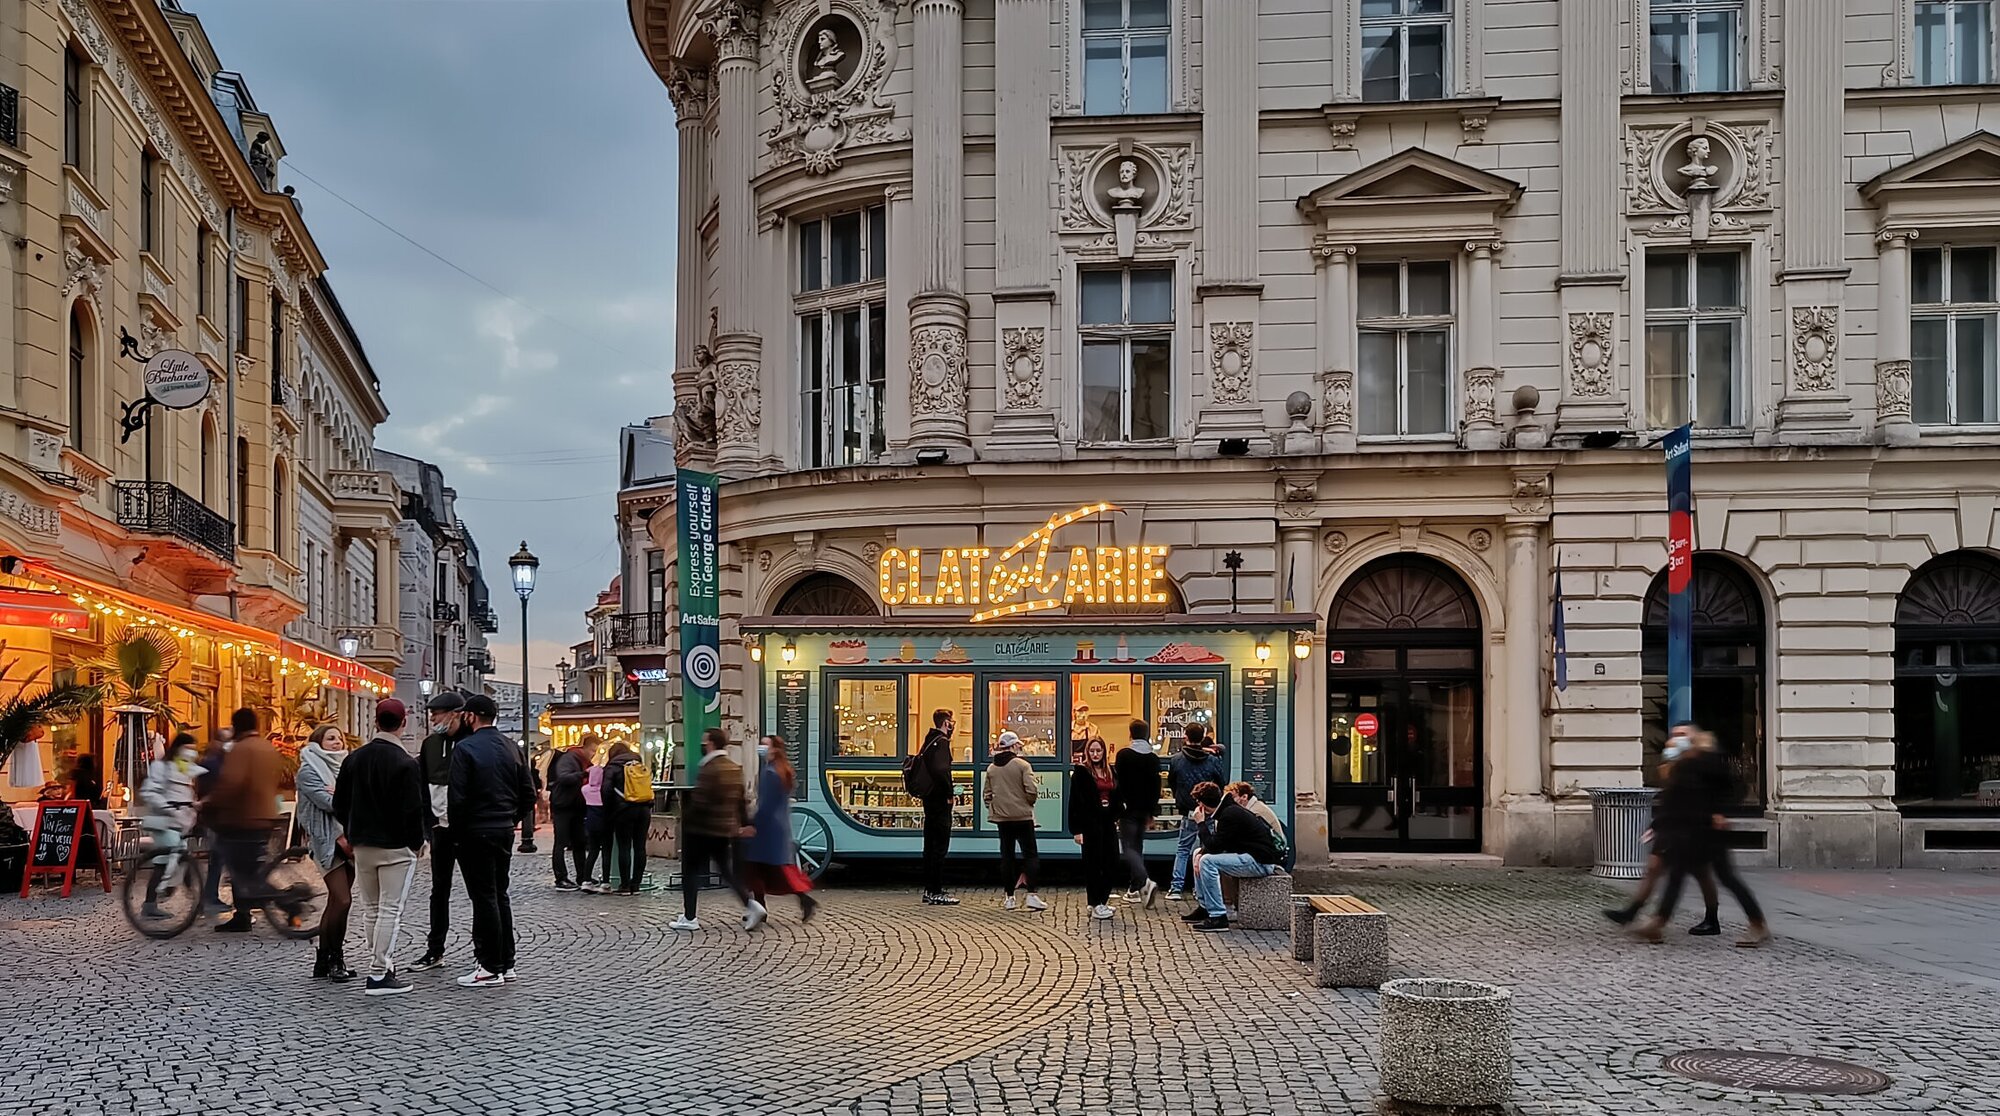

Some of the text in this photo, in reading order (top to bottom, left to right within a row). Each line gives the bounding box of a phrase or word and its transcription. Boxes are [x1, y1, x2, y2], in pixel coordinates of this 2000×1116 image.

[161, 359, 189, 373] Little
[146, 369, 199, 384] Bucharest
[700, 486, 712, 531] Circles
[686, 483, 702, 597] Express yourself
[702, 534, 715, 583] George
[682, 612, 720, 626] Art Safar
[1157, 697, 1209, 711] Collect your
